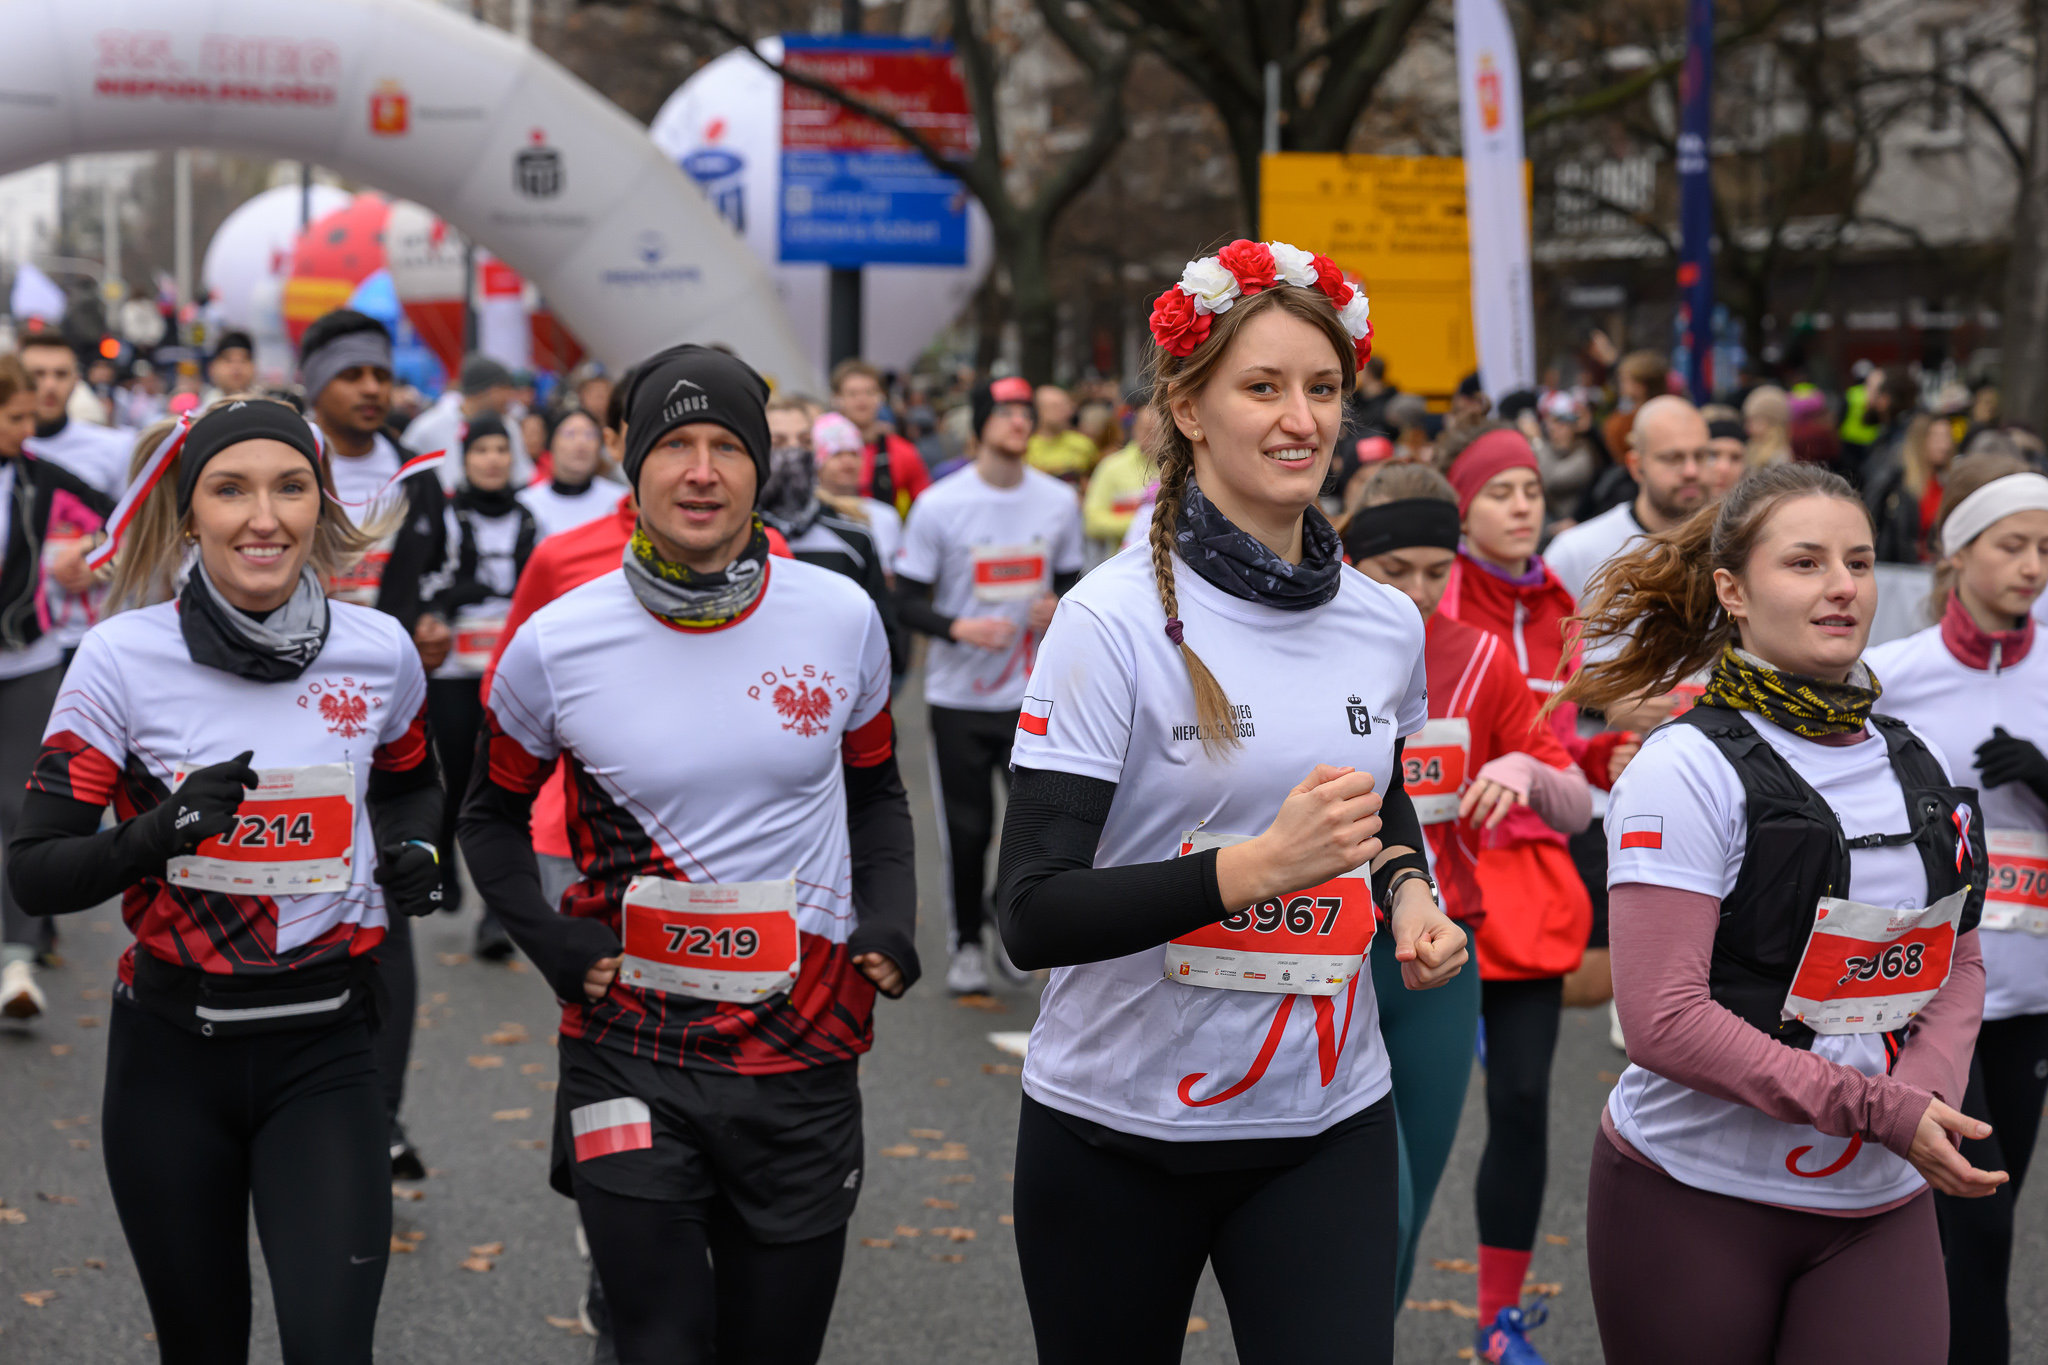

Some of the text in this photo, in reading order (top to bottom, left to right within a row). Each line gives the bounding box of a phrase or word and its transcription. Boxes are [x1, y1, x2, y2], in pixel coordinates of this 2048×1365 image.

[663, 394, 709, 422] ELBRUS
[296, 676, 383, 710] POLSKA
[746, 664, 848, 701] POLSKA
[217, 812, 314, 848] 7214
[1220, 896, 1343, 936] 3967
[663, 923, 760, 960] 7219
[1837, 942, 1925, 986] 3968
